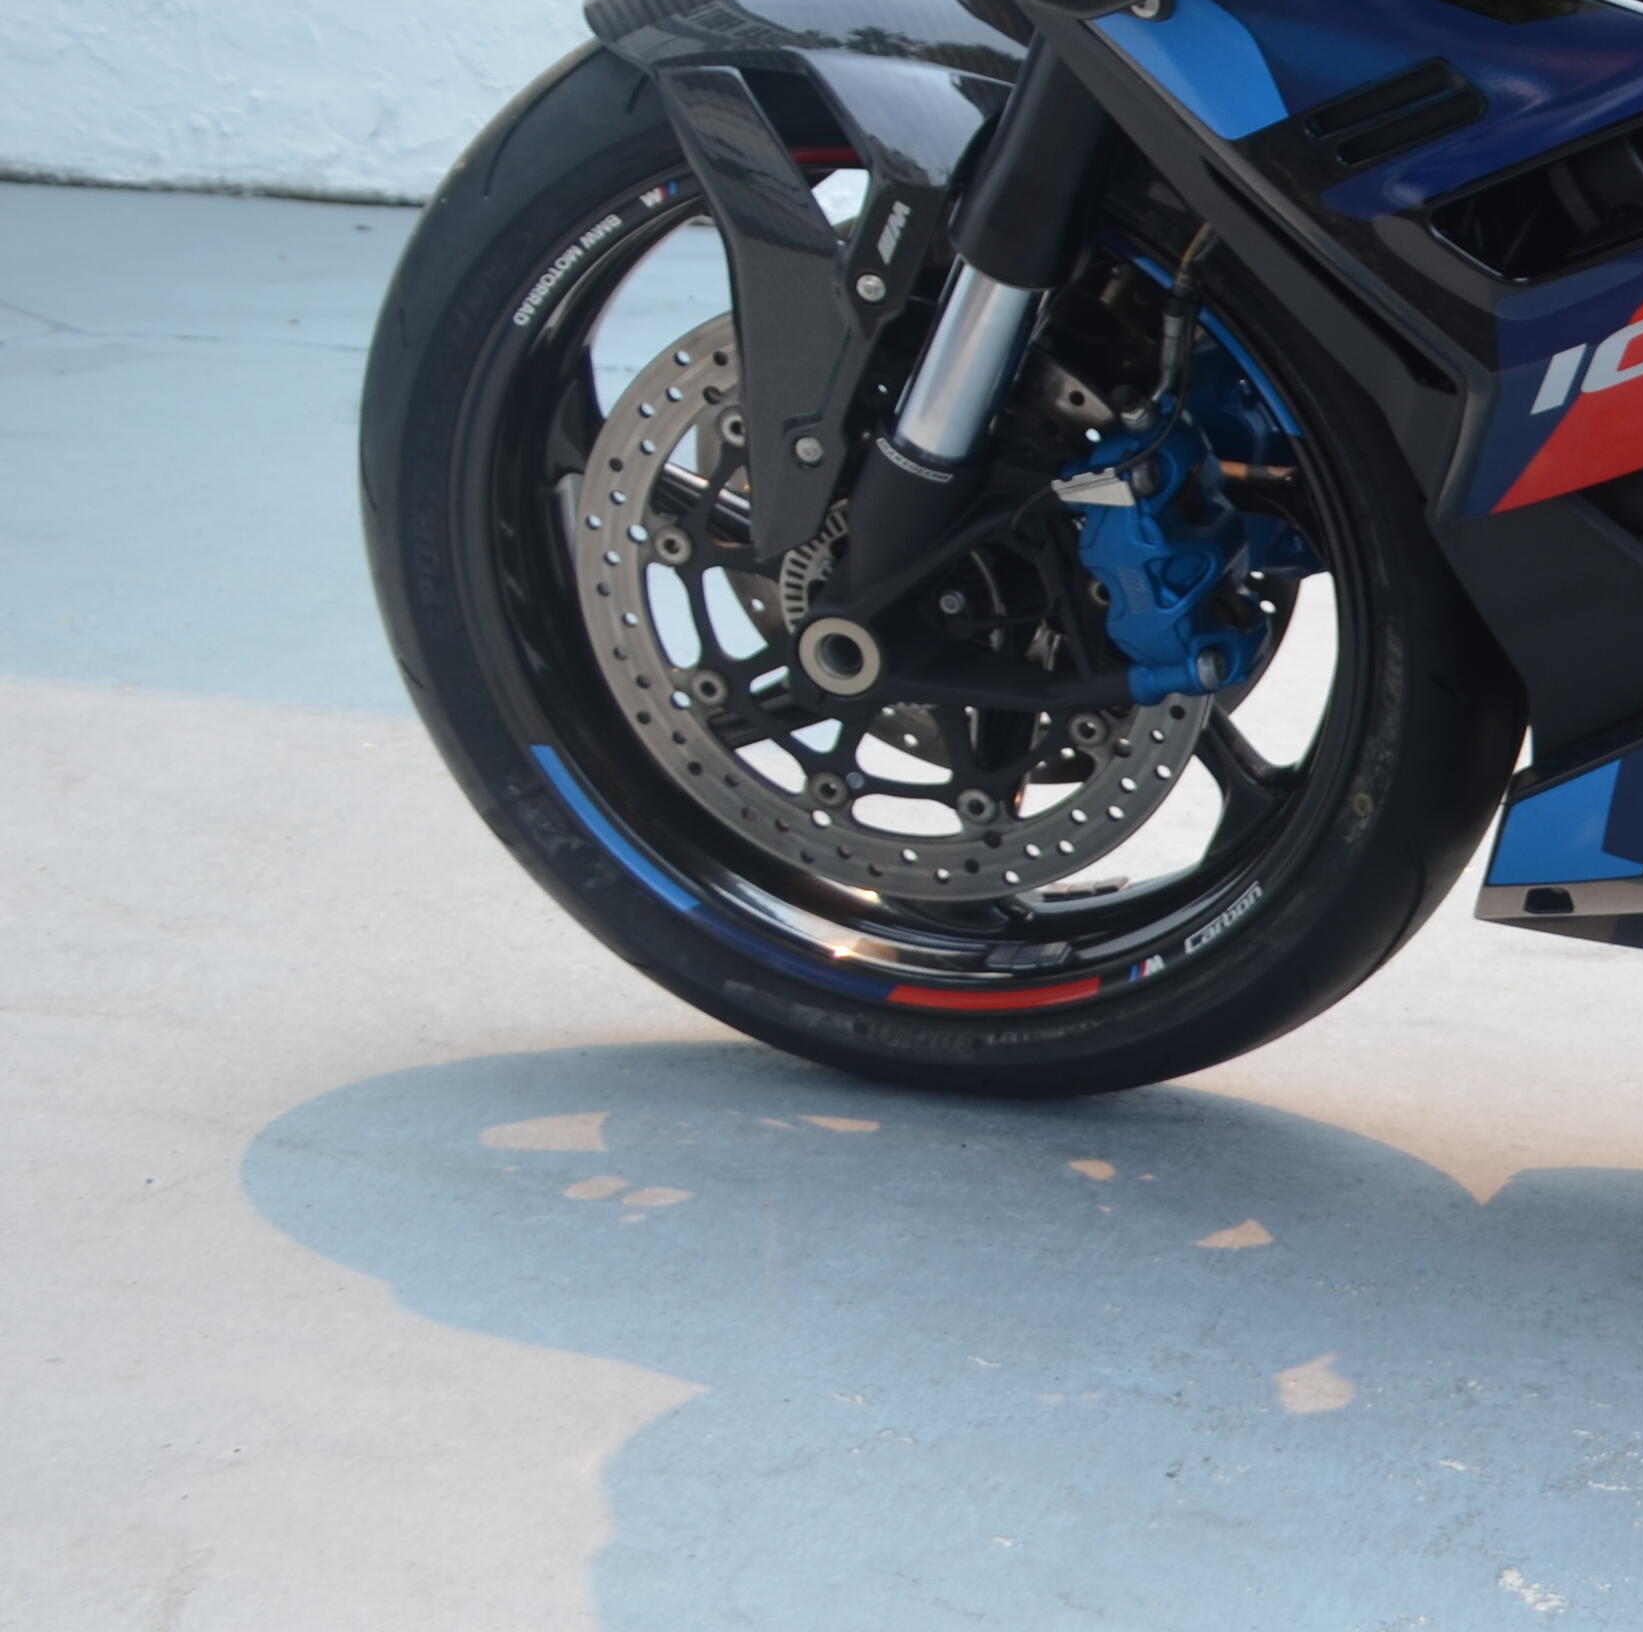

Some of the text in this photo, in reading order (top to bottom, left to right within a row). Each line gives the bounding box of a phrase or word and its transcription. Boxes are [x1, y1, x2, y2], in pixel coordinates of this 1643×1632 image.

[513, 214, 623, 326] BMW MOTORRAD
[1184, 880, 1263, 955] Carbon
